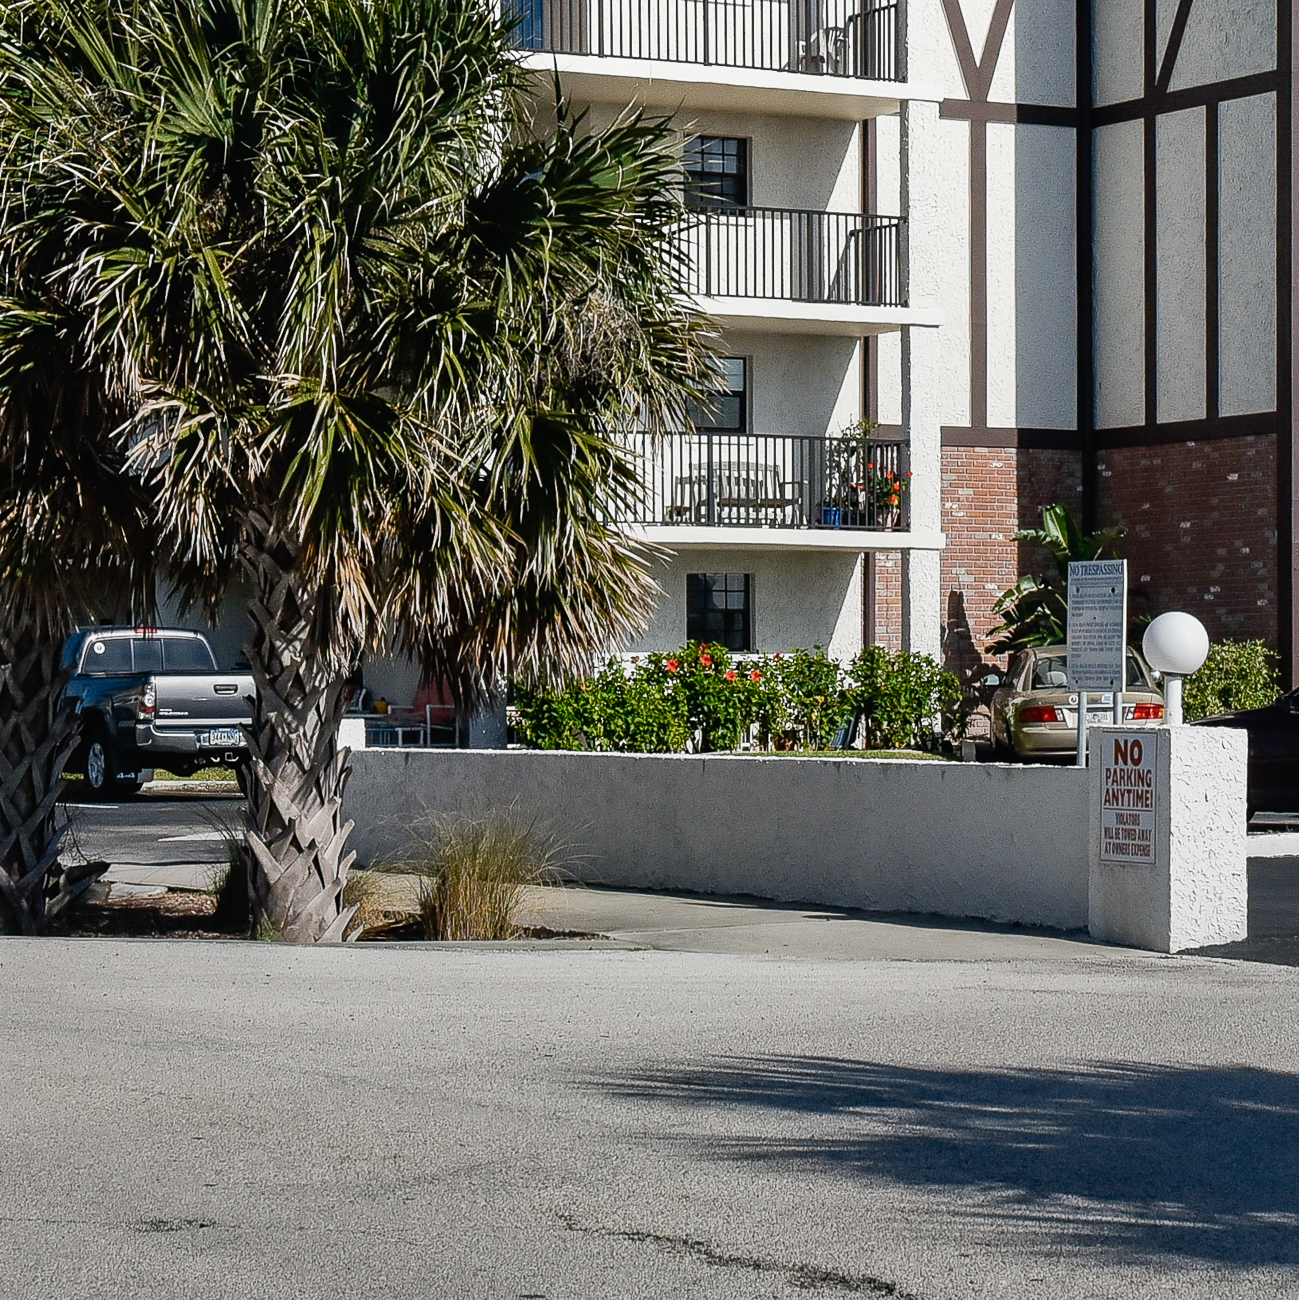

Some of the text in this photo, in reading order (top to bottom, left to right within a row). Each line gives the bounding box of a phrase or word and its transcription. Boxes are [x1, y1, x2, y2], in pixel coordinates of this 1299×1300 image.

[1070, 563, 1123, 576] NO TRESPASSING
[1114, 738, 1143, 767] NO
[1105, 768, 1152, 788] PARKING
[1104, 788, 1153, 808] ANYTIME!
[1115, 813, 1141, 827] VIOLATORS
[1104, 827, 1152, 842] WILL BE TOWED AWAY
[1104, 841, 1112, 855] AT
[1131, 843, 1150, 857] EXPENSE
